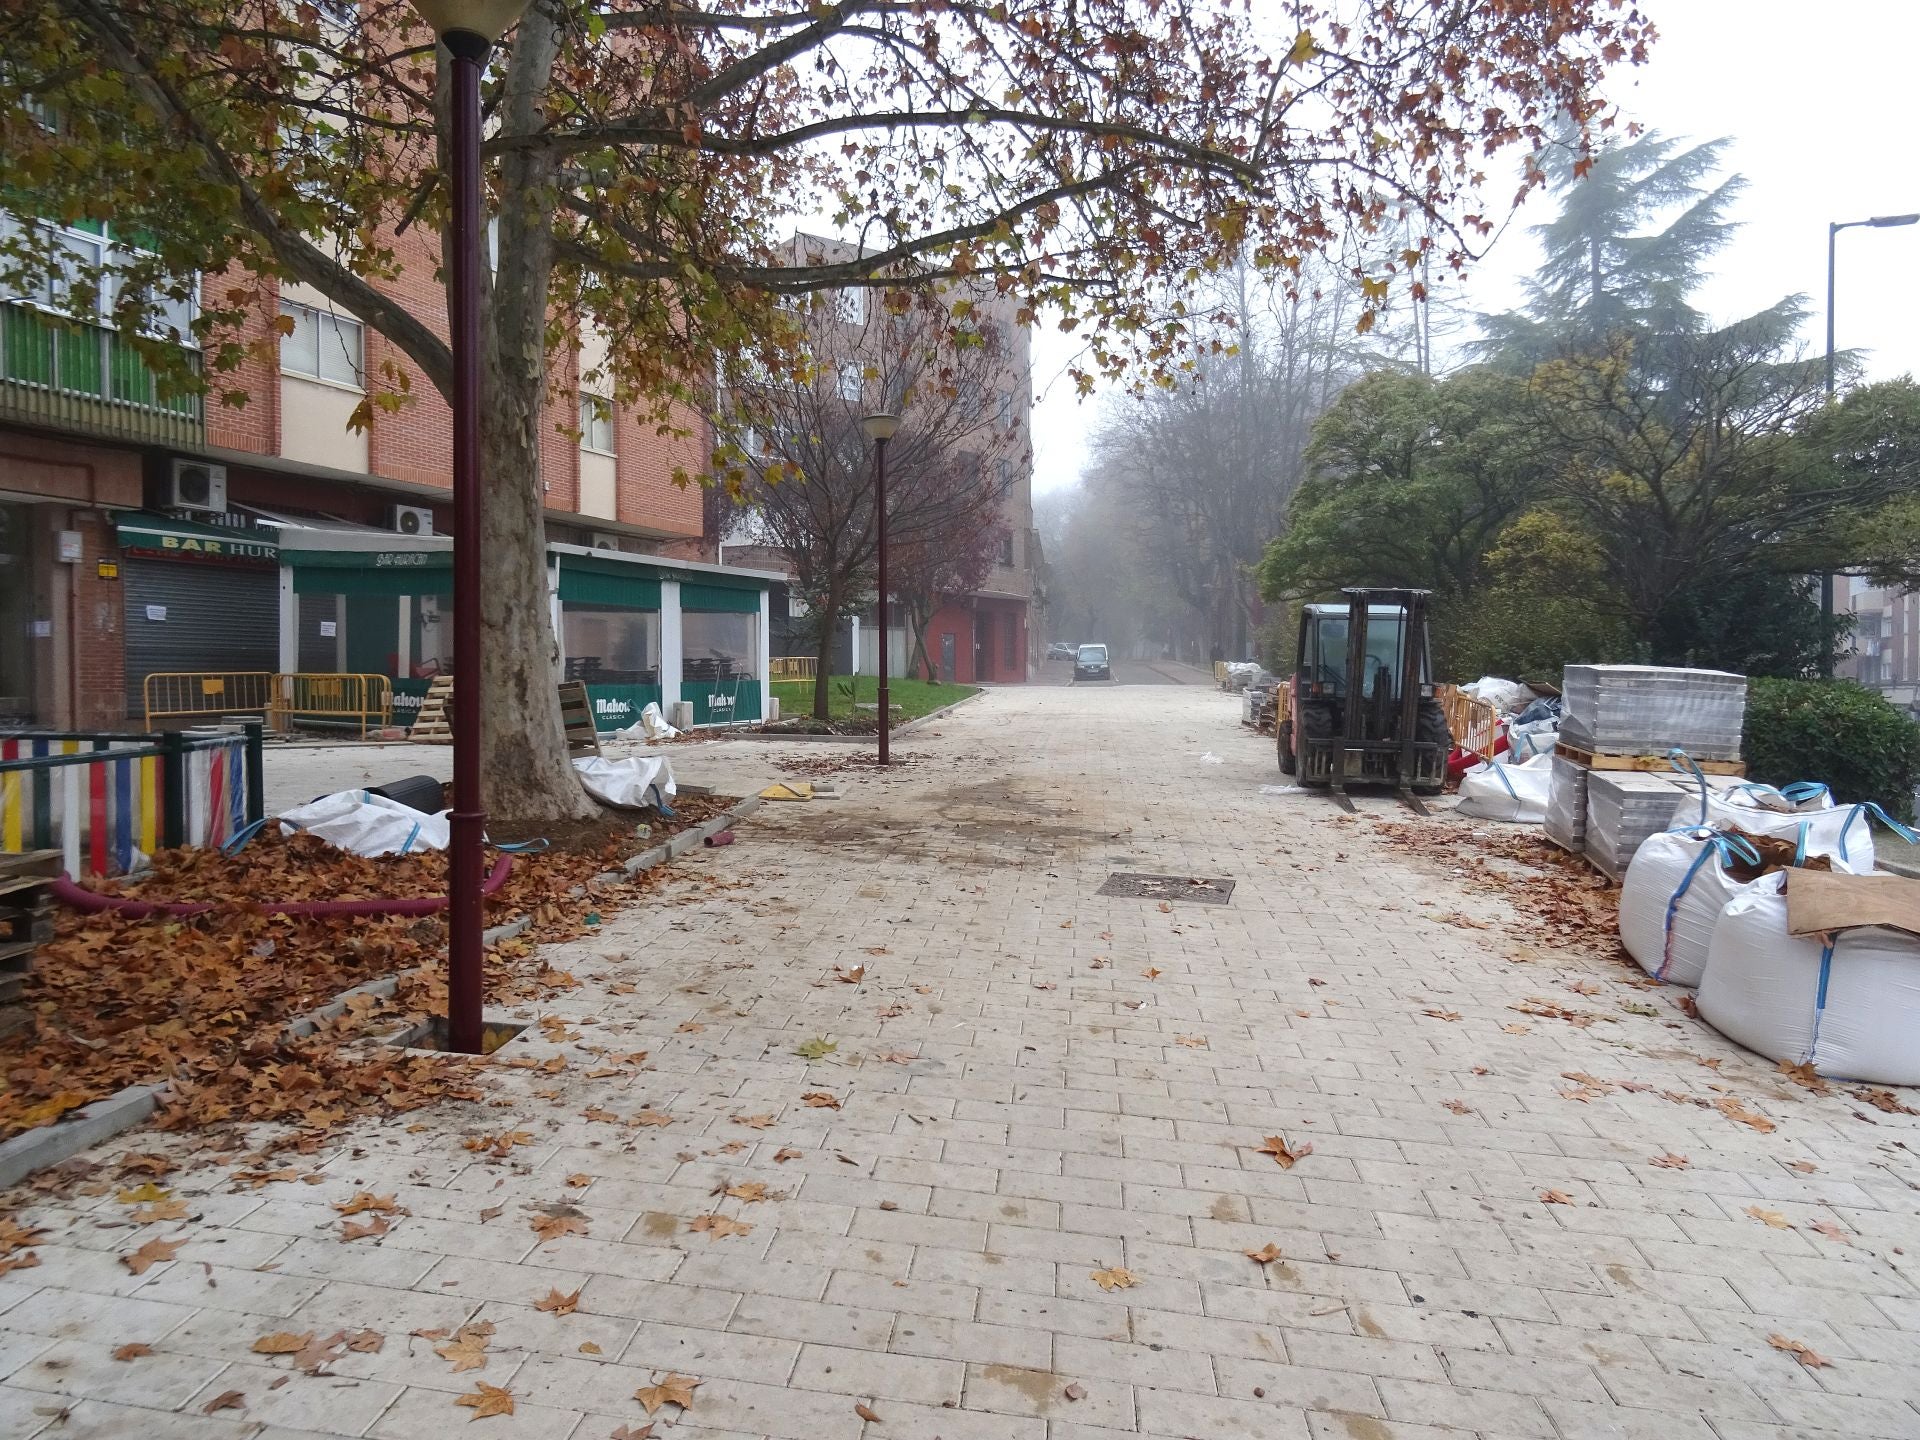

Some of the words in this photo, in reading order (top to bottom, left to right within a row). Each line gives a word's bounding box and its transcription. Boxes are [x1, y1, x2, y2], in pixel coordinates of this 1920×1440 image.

[162, 536, 222, 553] BAR
[229, 543, 277, 559] HUR
[596, 698, 631, 714] Mahou
